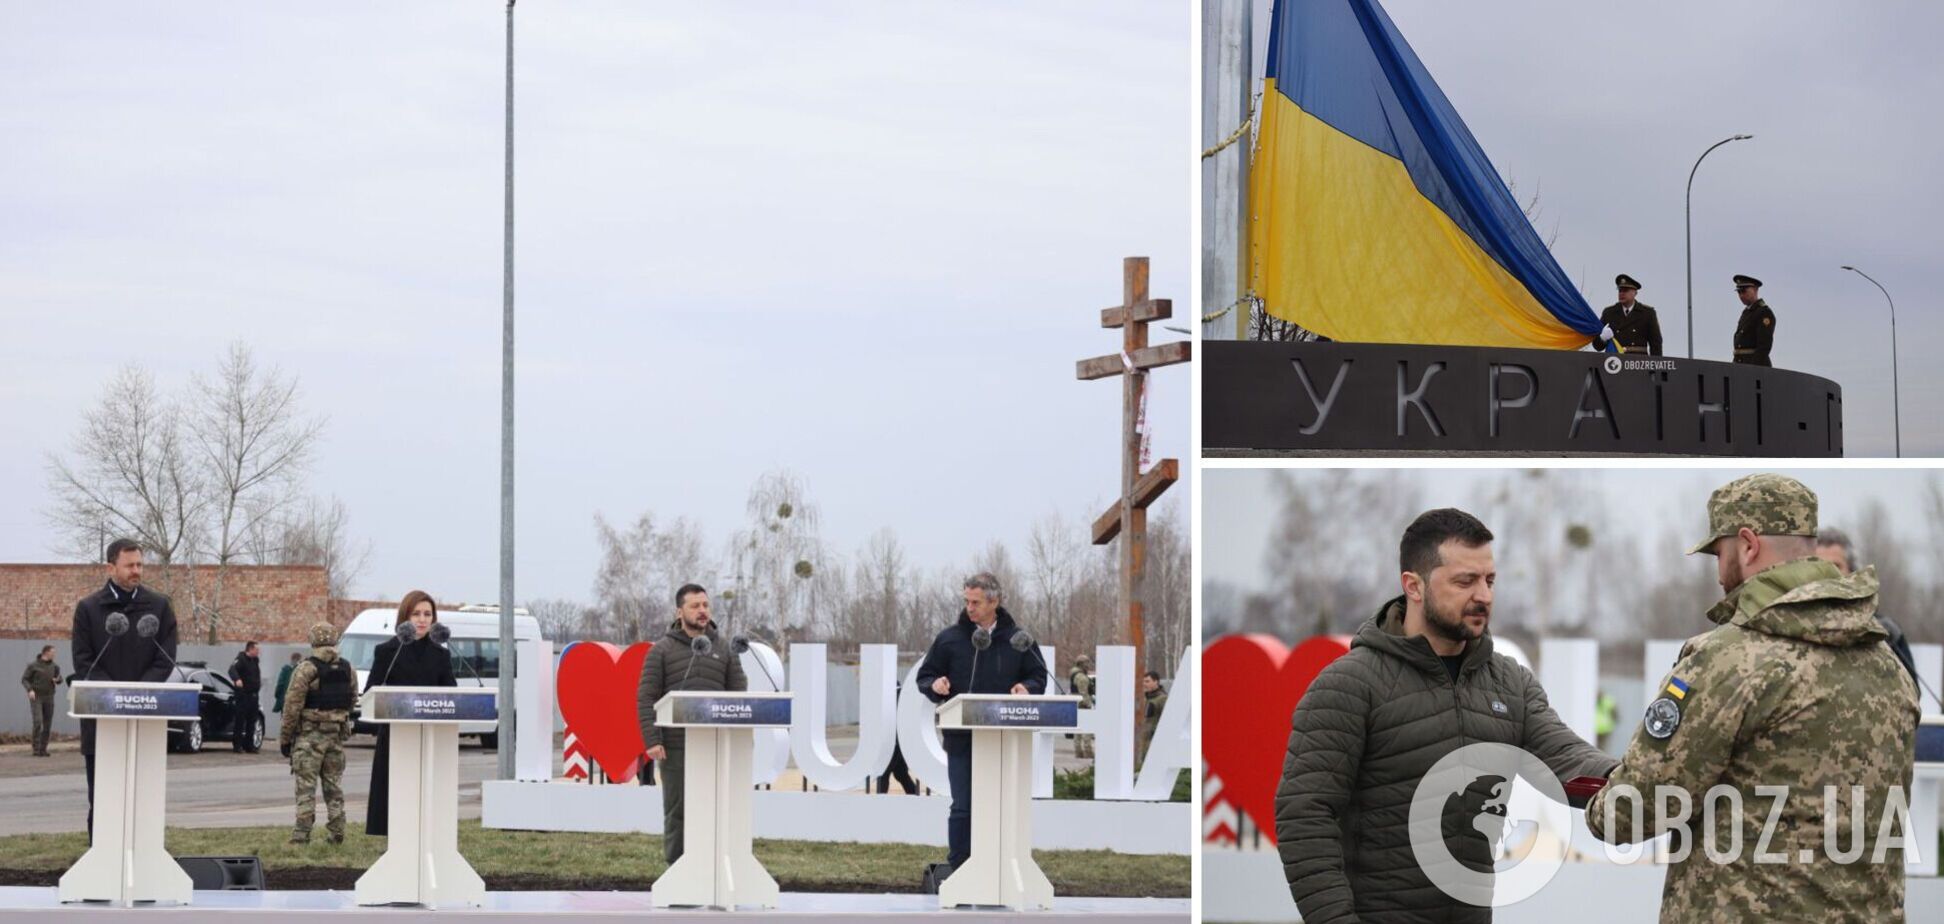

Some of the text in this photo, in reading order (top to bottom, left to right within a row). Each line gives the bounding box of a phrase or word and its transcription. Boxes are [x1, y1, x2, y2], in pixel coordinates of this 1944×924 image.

[114, 695, 157, 704] BUCHA
[413, 700, 456, 708] BUCHA
[711, 704, 752, 712] BUCHA
[999, 706, 1040, 715] BUCHA
